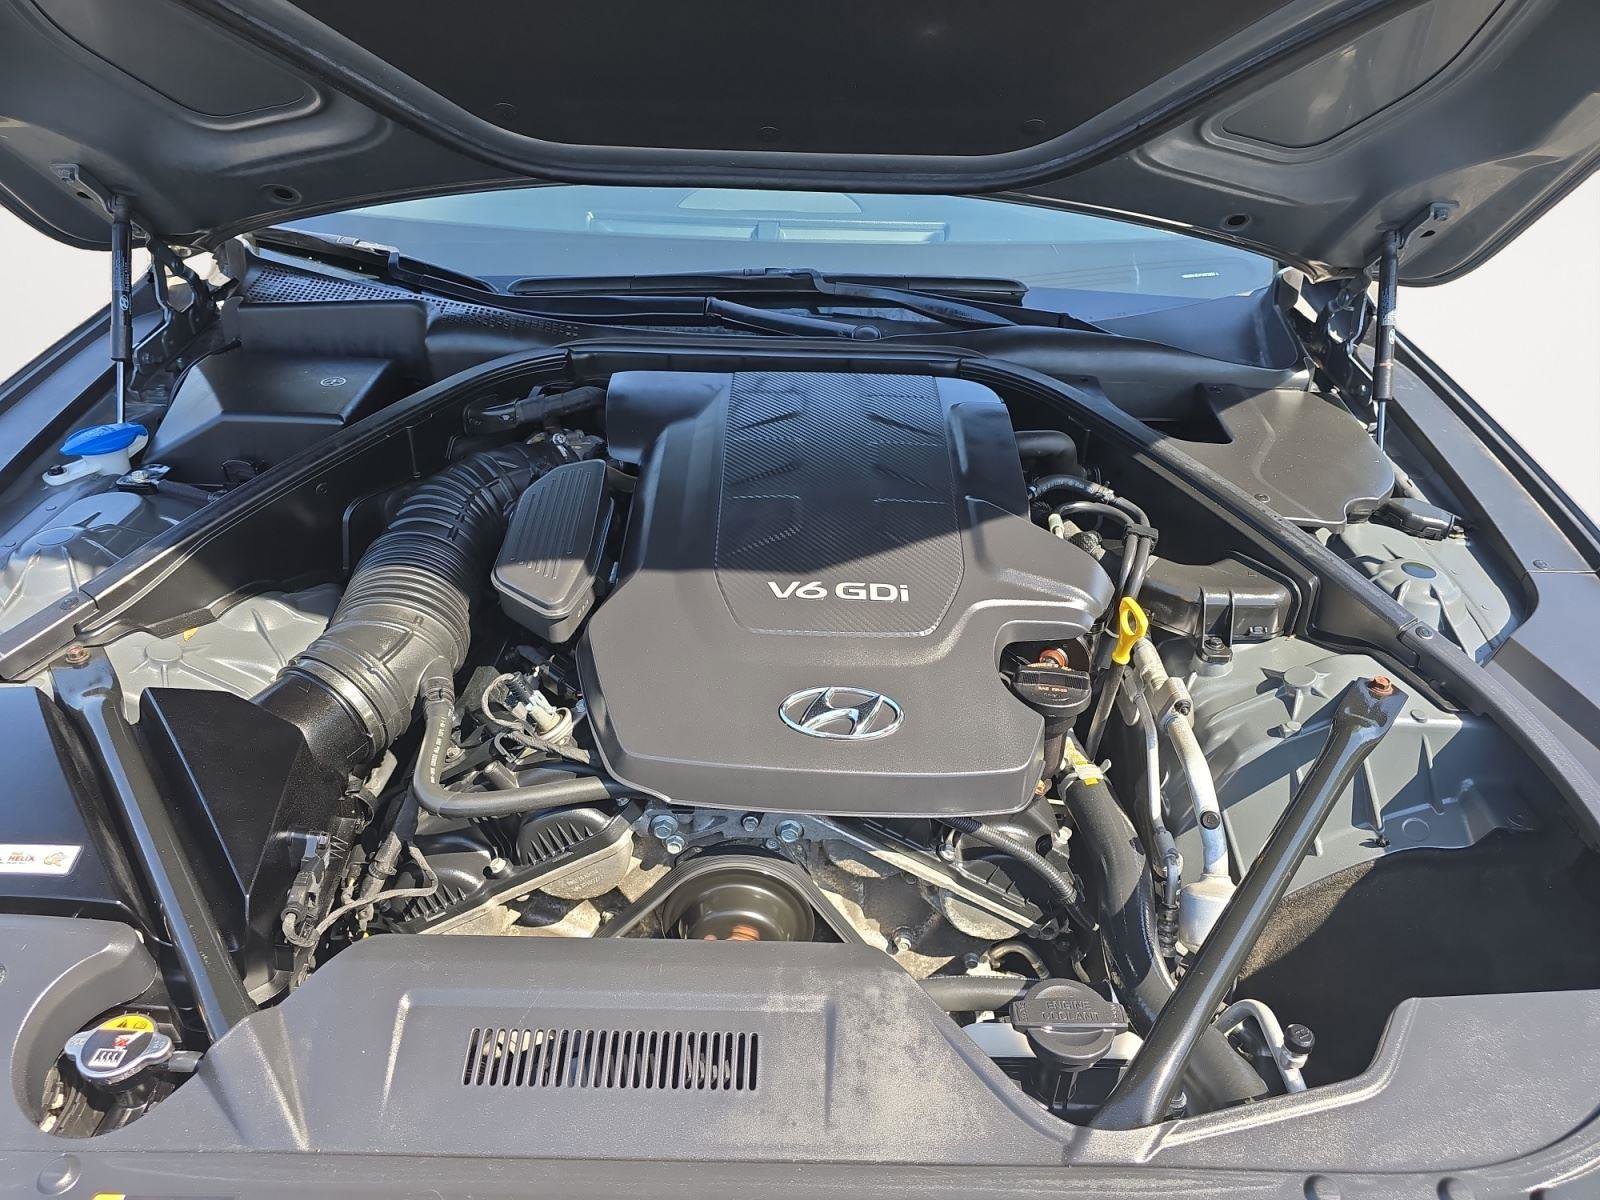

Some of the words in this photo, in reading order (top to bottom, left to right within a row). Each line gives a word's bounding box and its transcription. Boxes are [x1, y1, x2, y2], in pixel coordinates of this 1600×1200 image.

[767, 581, 828, 599] V6
[835, 582, 910, 602] GDi
[1046, 1000, 1091, 1010] ENGINE
[1041, 1011, 1099, 1021] COOLANT
